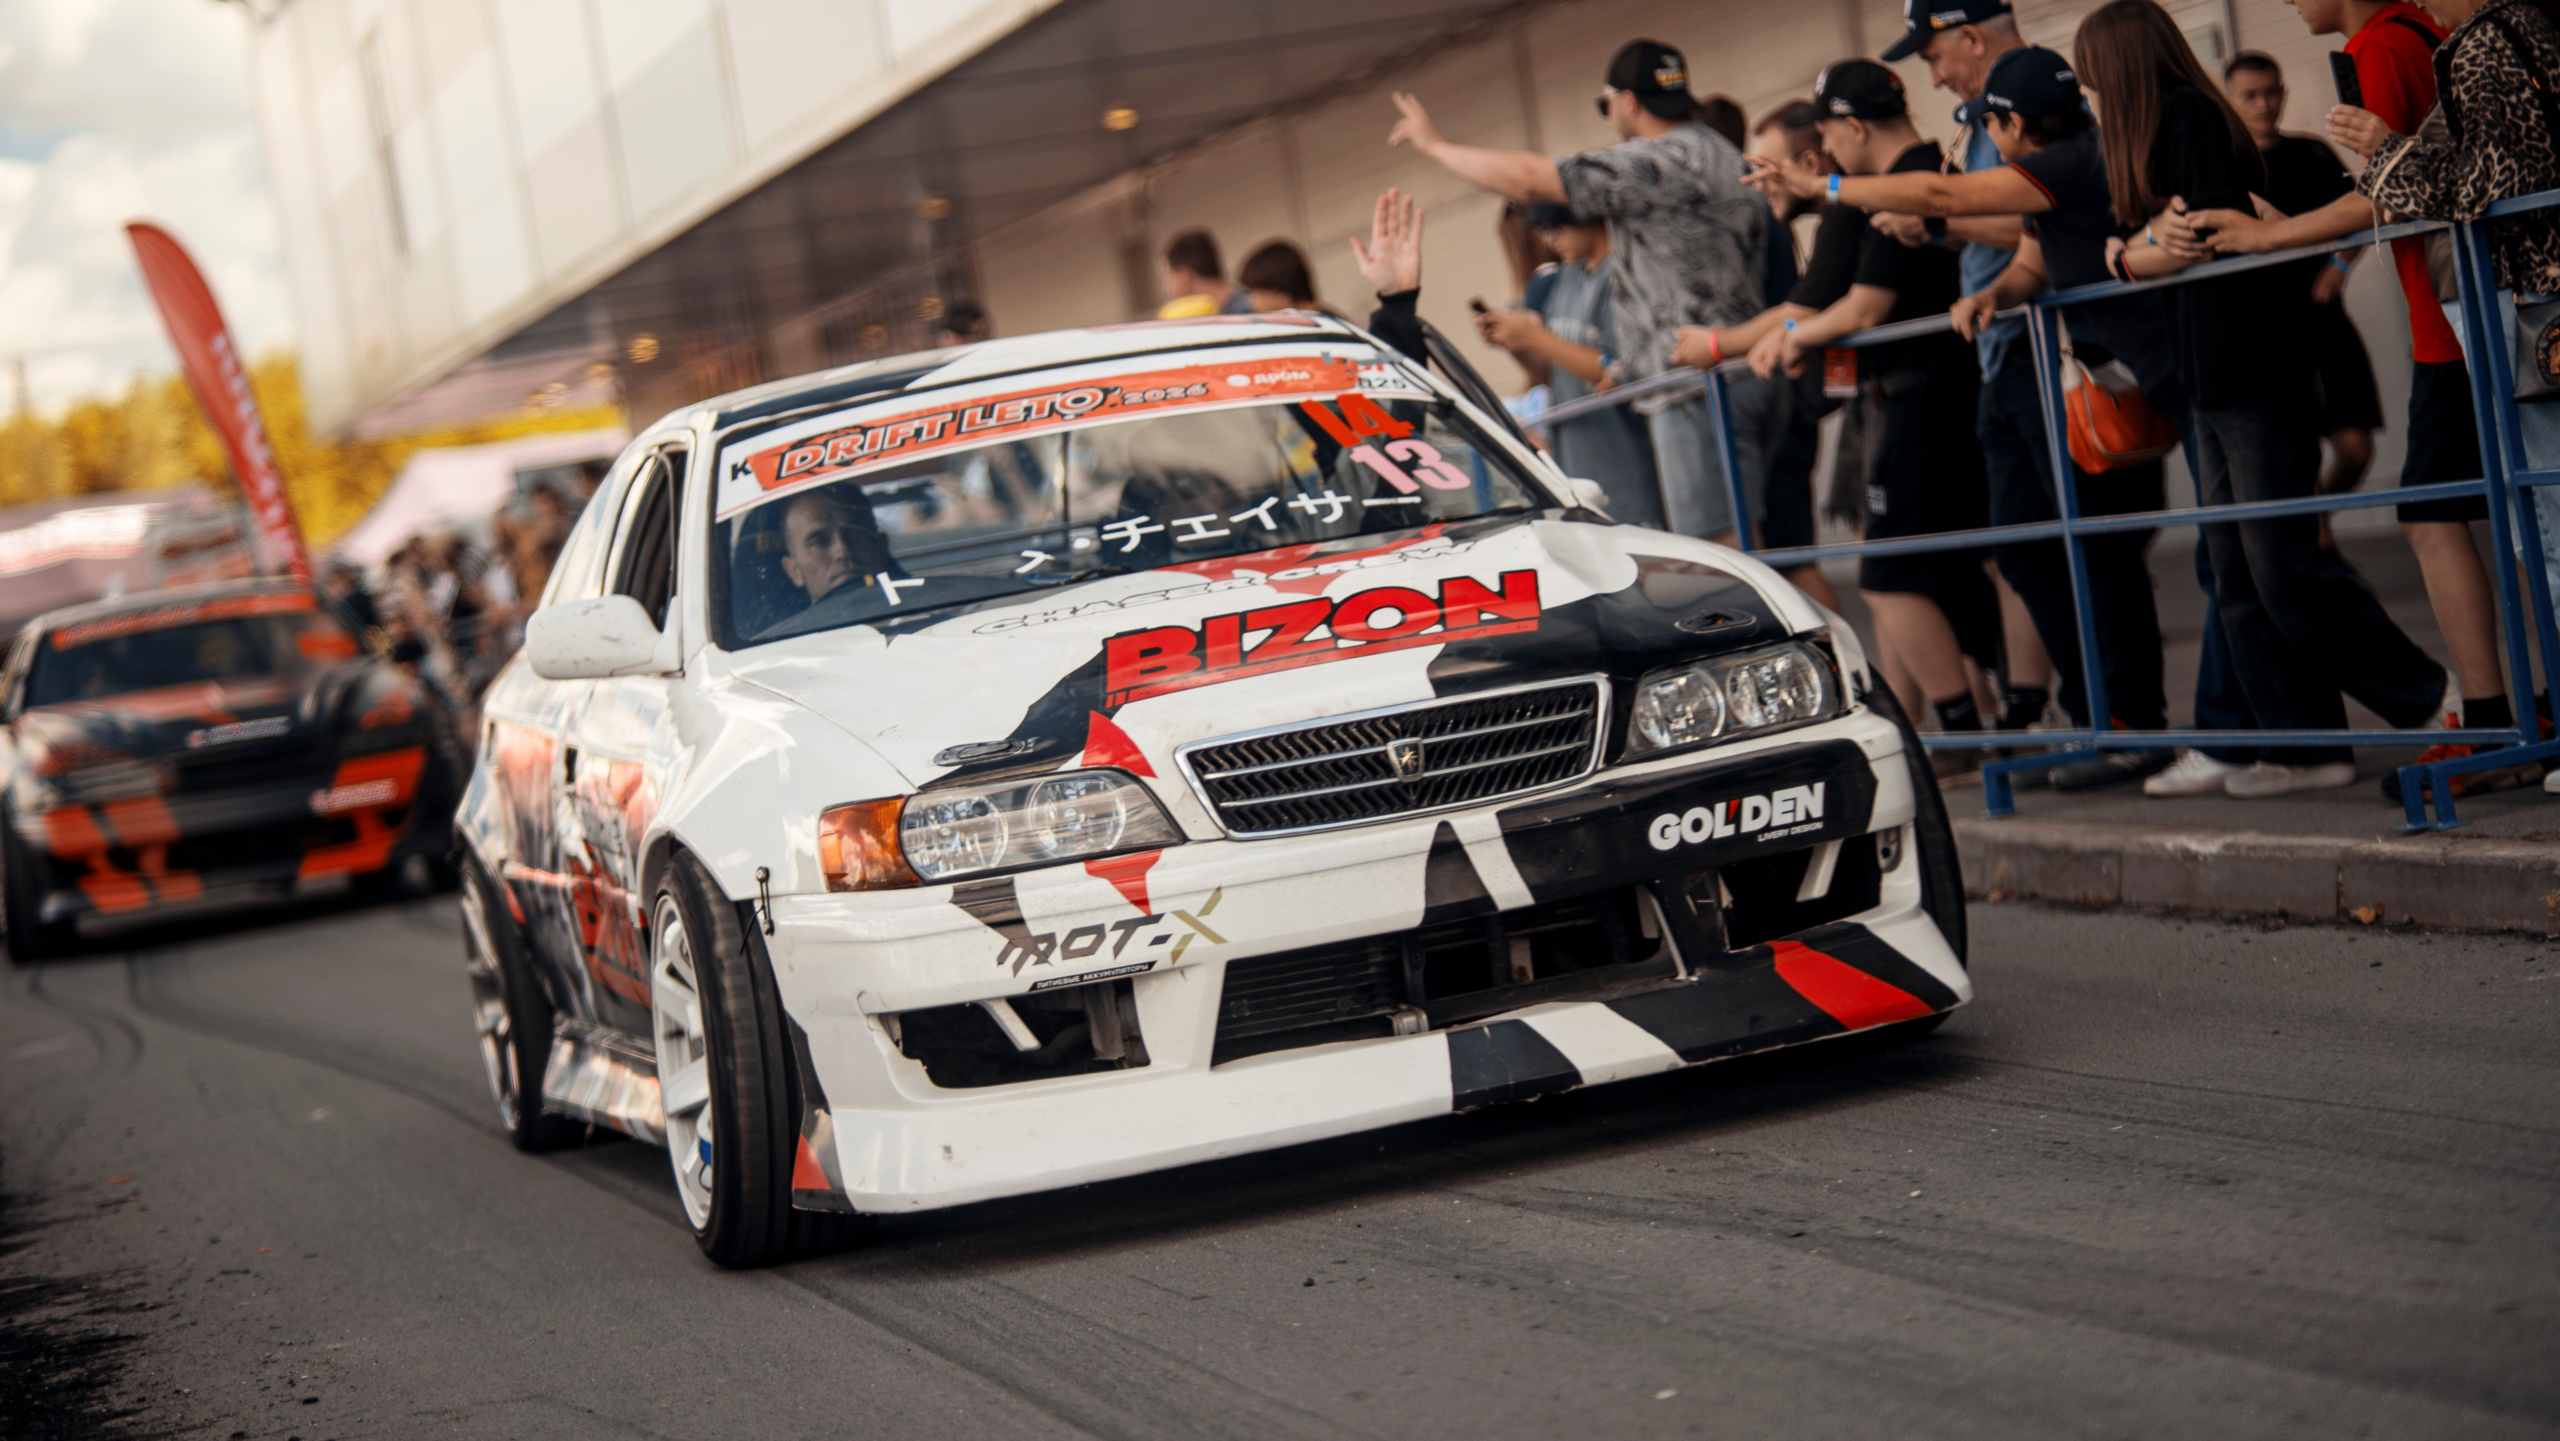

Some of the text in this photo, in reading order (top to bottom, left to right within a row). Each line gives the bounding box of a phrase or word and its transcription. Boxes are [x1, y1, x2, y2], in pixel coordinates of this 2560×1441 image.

[775, 381, 1209, 481] DRIFT LETO 2026
[1299, 393, 1415, 449] 14
[1350, 438, 1471, 494] 13
[973, 539, 1476, 635] CHASER CREW
[1101, 568, 1541, 693] BIZON
[1082, 963, 1149, 982] АККУМУЛЯТОРЫ
